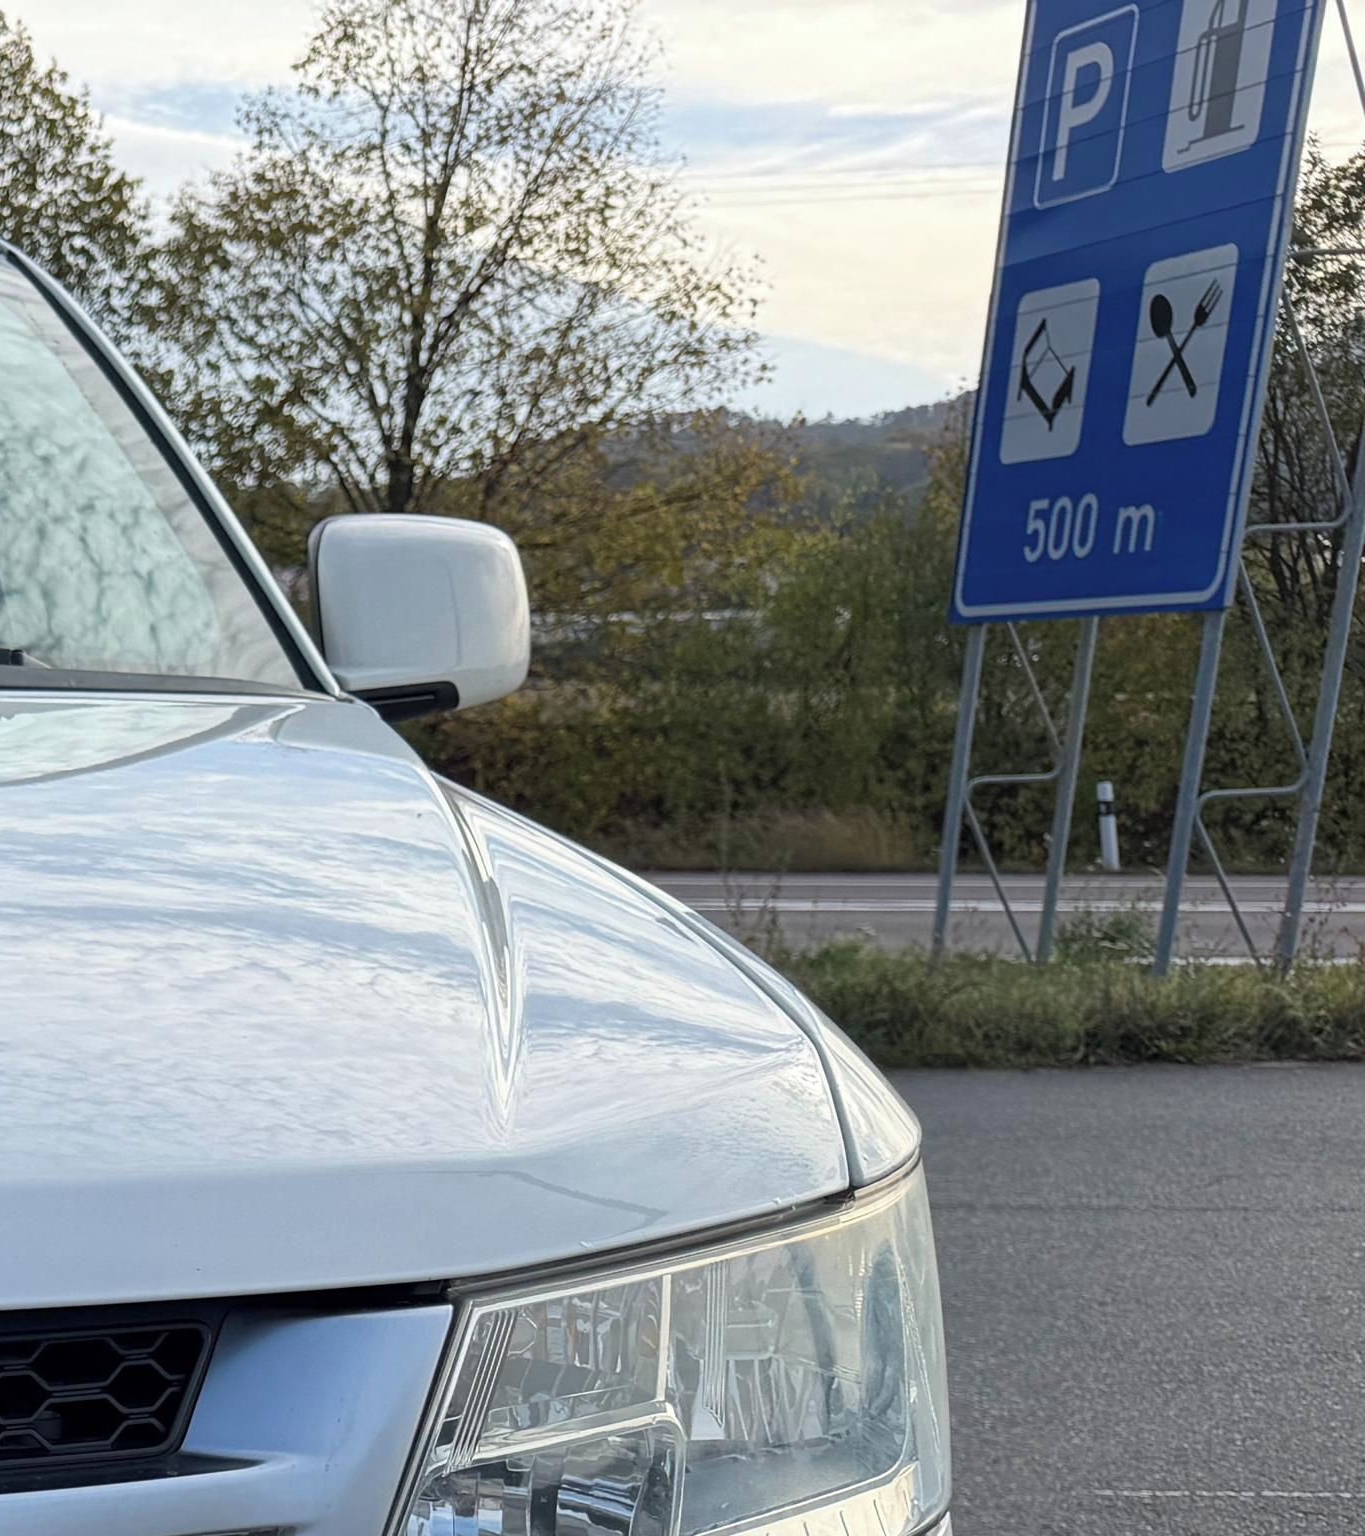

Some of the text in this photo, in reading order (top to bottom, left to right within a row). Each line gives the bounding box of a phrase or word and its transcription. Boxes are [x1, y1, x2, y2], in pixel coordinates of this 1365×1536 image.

[1051, 41, 1114, 182] P
[1023, 492, 1156, 563] 500 m
